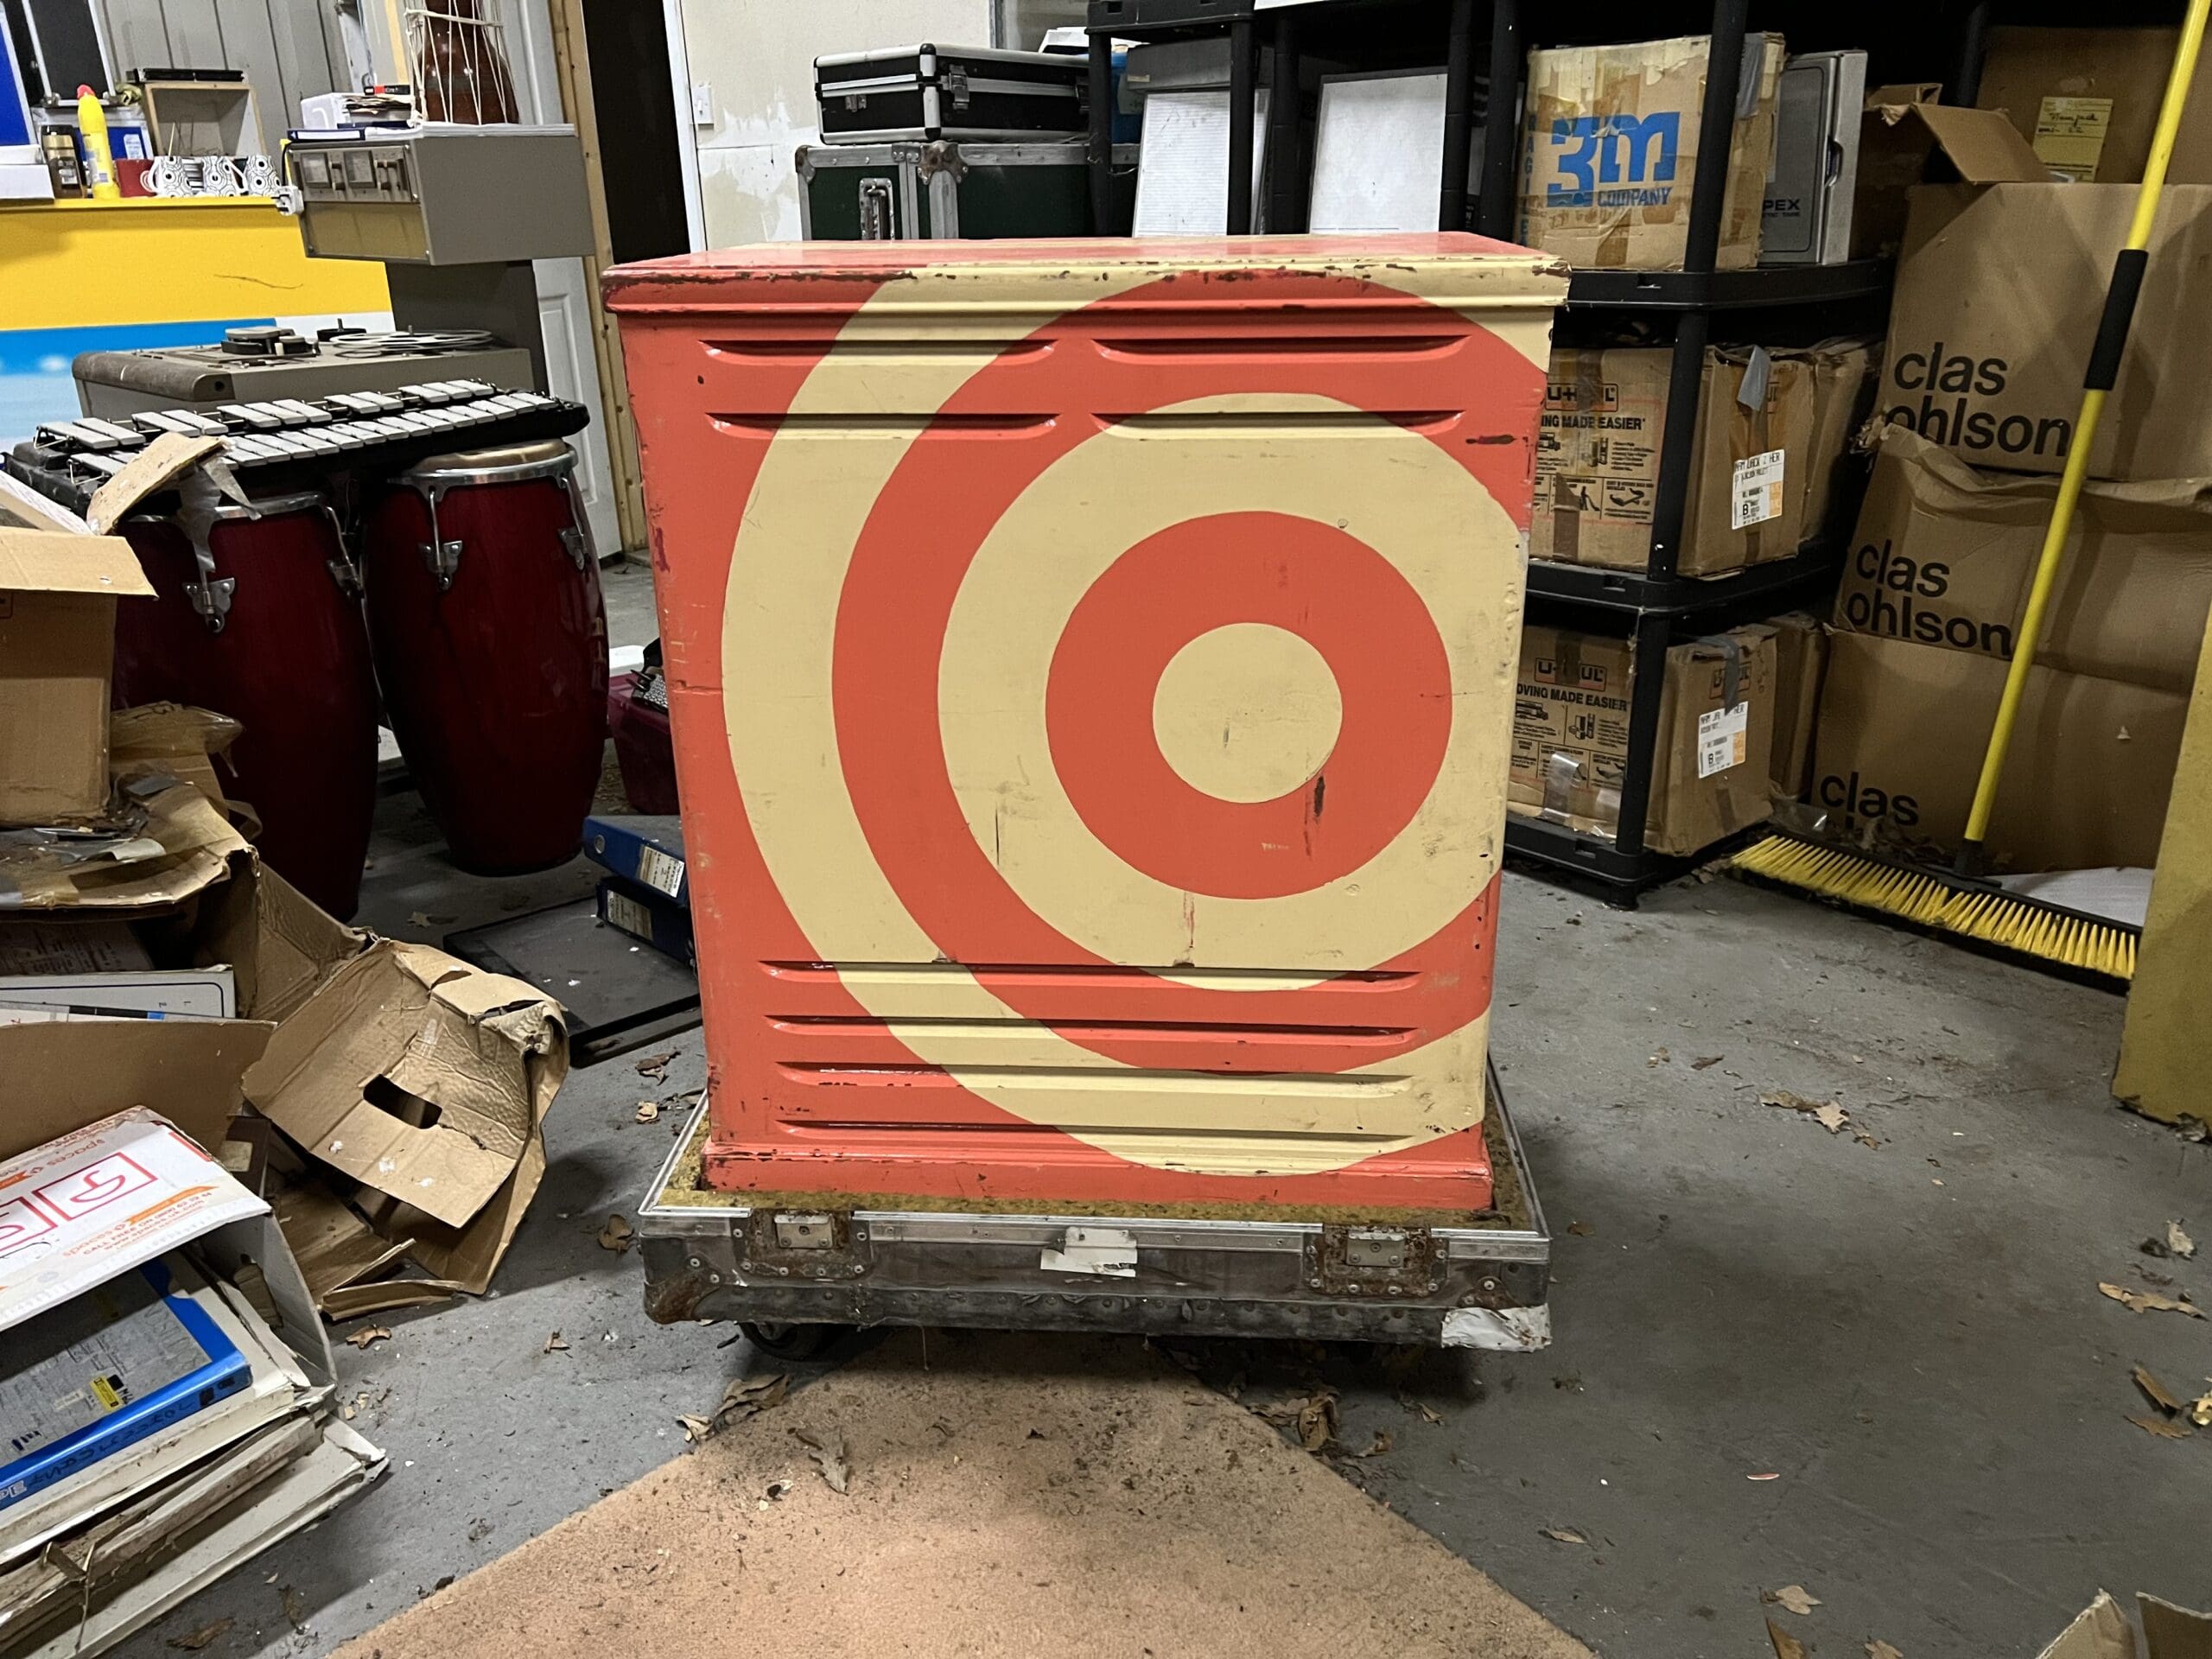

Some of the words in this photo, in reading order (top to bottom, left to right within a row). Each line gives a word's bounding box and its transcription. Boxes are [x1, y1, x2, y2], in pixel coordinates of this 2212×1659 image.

[1598, 187, 1672, 207] COMPANY
[1763, 199, 1800, 211] PEX
[1894, 342, 2007, 396] clas
[1541, 415, 1560, 427] ING
[1561, 416, 1595, 429] MADE
[1857, 539, 1949, 597] clas
[1847, 588, 2012, 656] ohlson
[1517, 683, 1548, 698] OVING
[1550, 689, 1583, 704] MADE
[1821, 772, 1919, 825] clas
